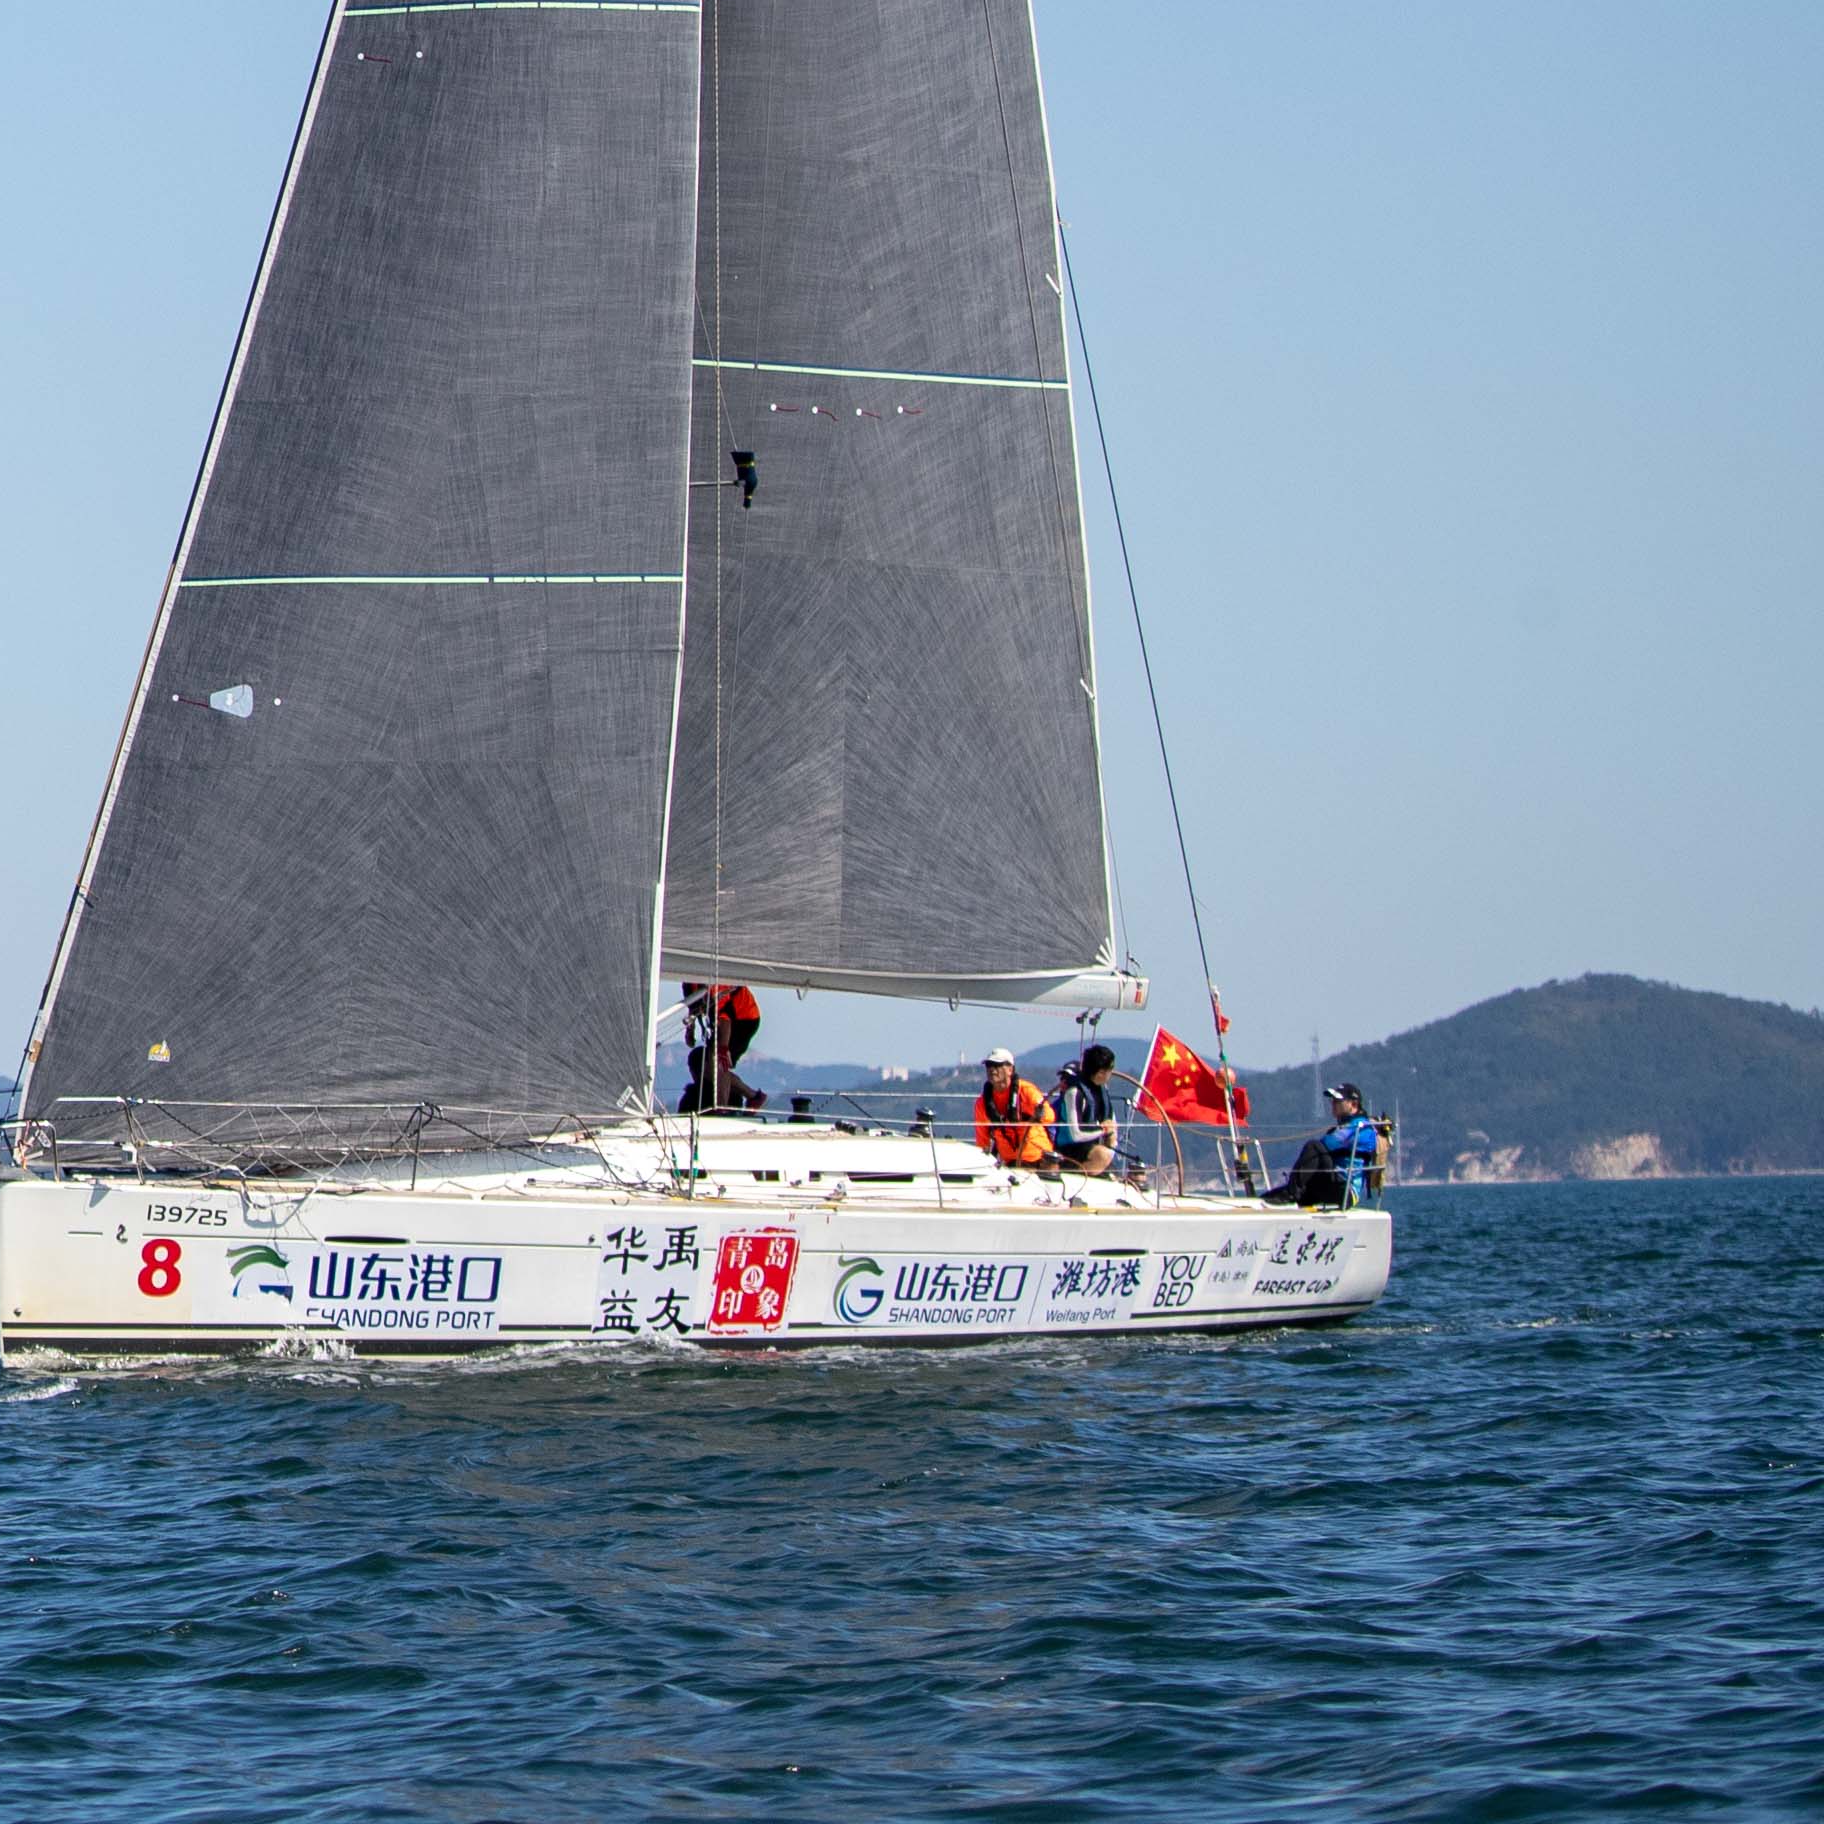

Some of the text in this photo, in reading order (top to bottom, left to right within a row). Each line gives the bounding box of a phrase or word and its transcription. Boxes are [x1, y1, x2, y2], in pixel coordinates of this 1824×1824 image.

[147, 1204, 228, 1228] 139725
[602, 1225, 699, 1274] 华禹
[726, 1236, 789, 1270] 青岛
[137, 1239, 182, 1297] 8
[309, 1252, 503, 1303] 山东港口
[894, 1257, 1141, 1301] 山东港口 潍坊港
[1161, 1255, 1206, 1281] YOU
[1153, 1282, 1194, 1307] BED
[1251, 1279, 1333, 1296] FAREAST CUP
[592, 1287, 693, 1335] 益友
[718, 1287, 780, 1320] 印象
[888, 1307, 1017, 1324] SHANDONG PORT
[1045, 1307, 1117, 1324] Weifang Port
[436, 1311, 495, 1330] PORT
